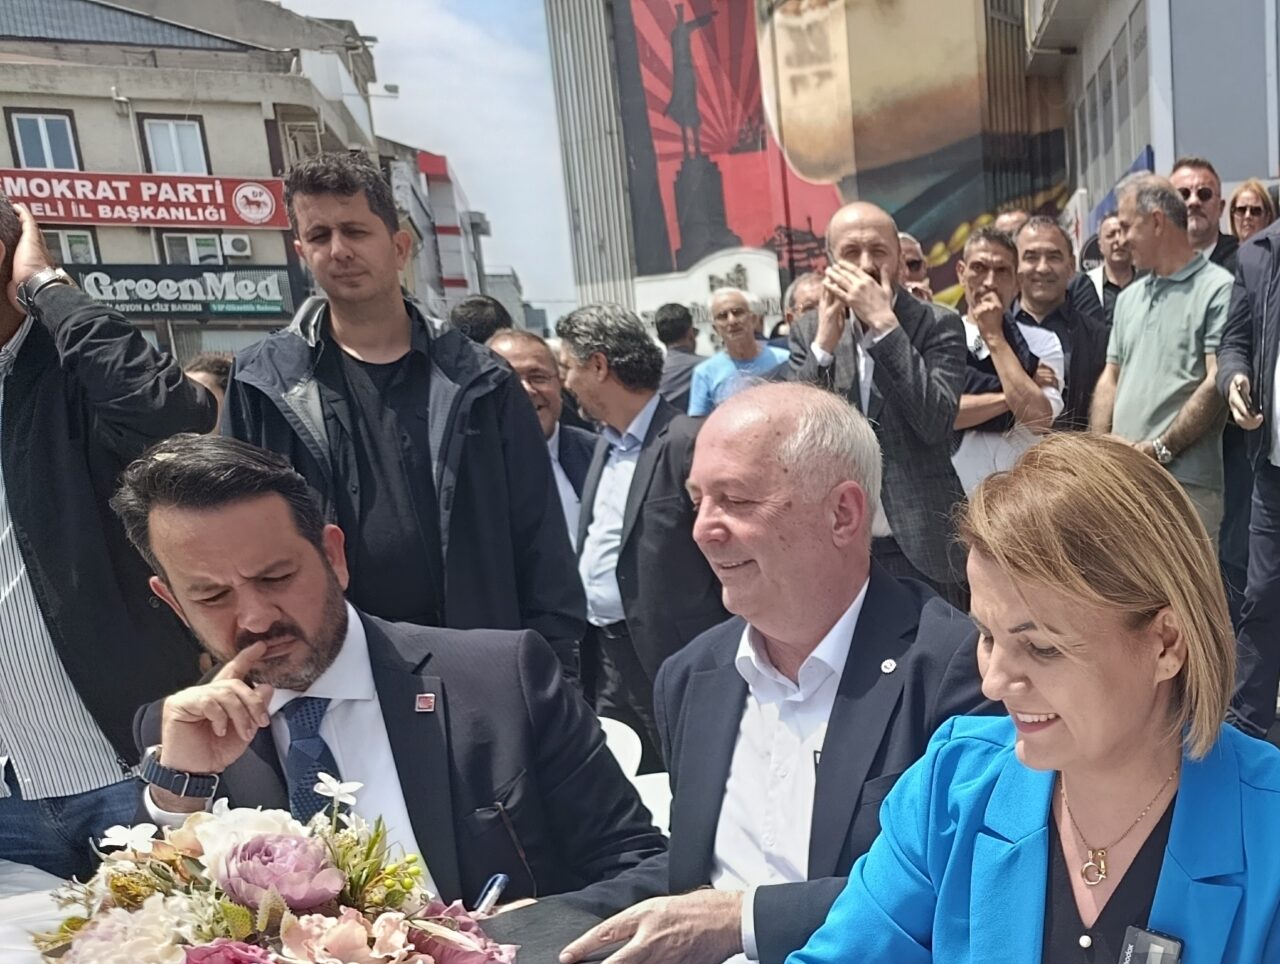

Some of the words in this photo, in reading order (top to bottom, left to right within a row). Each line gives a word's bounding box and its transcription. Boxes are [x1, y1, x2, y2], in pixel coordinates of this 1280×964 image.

[141, 179, 225, 205] PARTİ
[71, 202, 93, 218] İL
[98, 204, 227, 223] BAŞKANLIĞI
[84, 270, 283, 301] GreenMed
